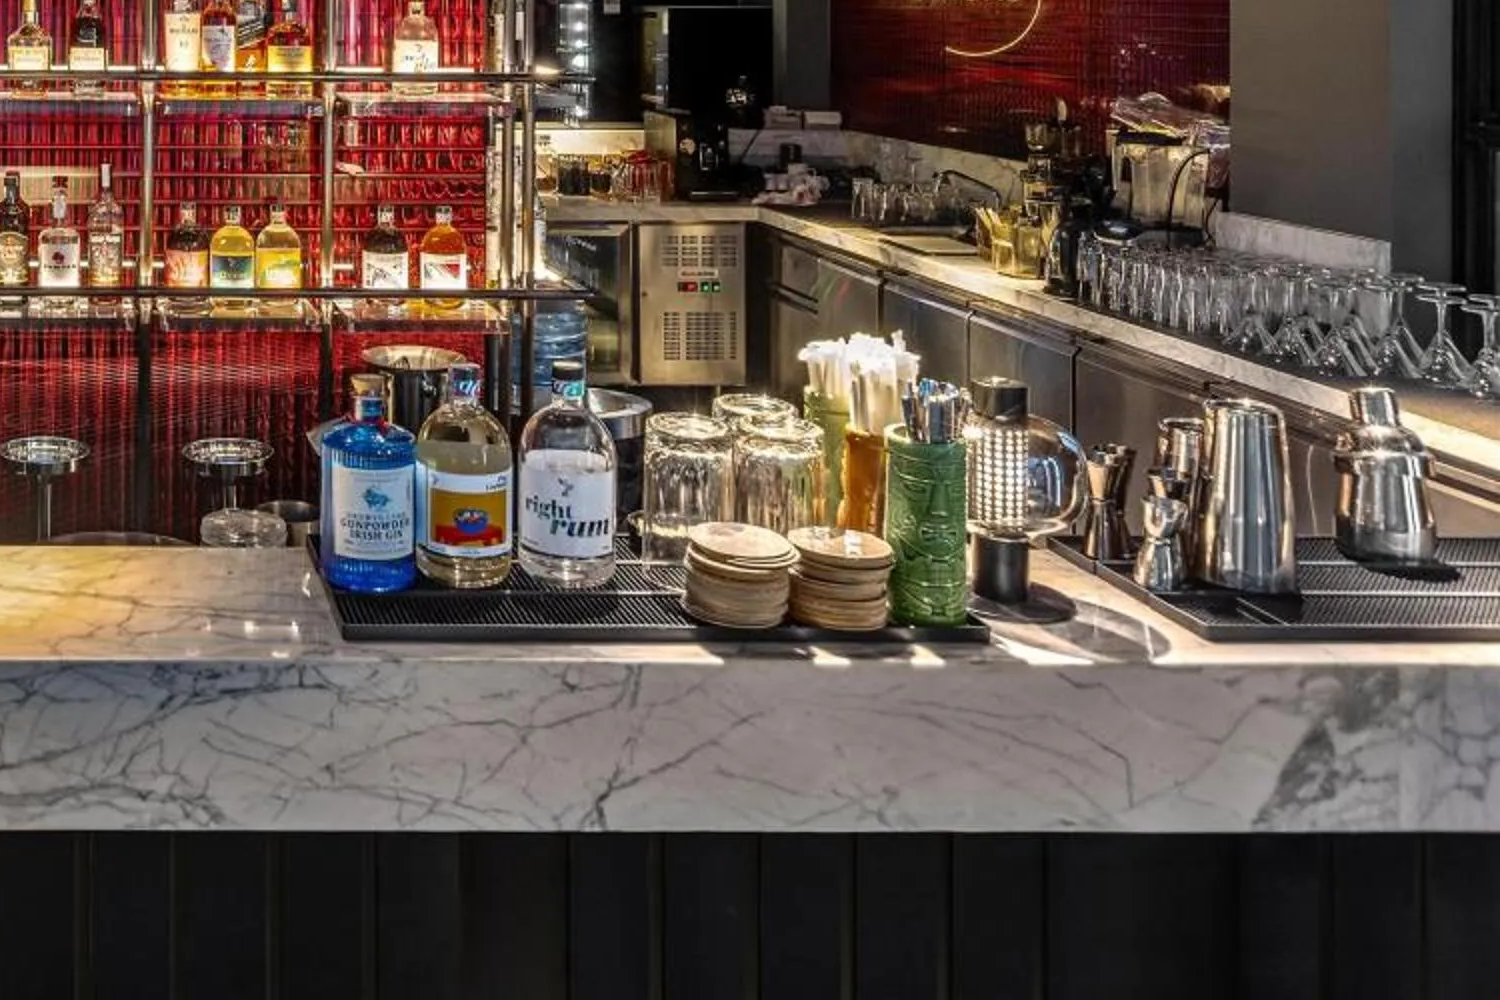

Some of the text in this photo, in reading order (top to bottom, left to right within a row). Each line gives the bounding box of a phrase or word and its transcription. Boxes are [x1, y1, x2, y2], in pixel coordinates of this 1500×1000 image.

[525, 494, 572, 520] right
[385, 529, 404, 540] GIN
[550, 519, 609, 538] rum
